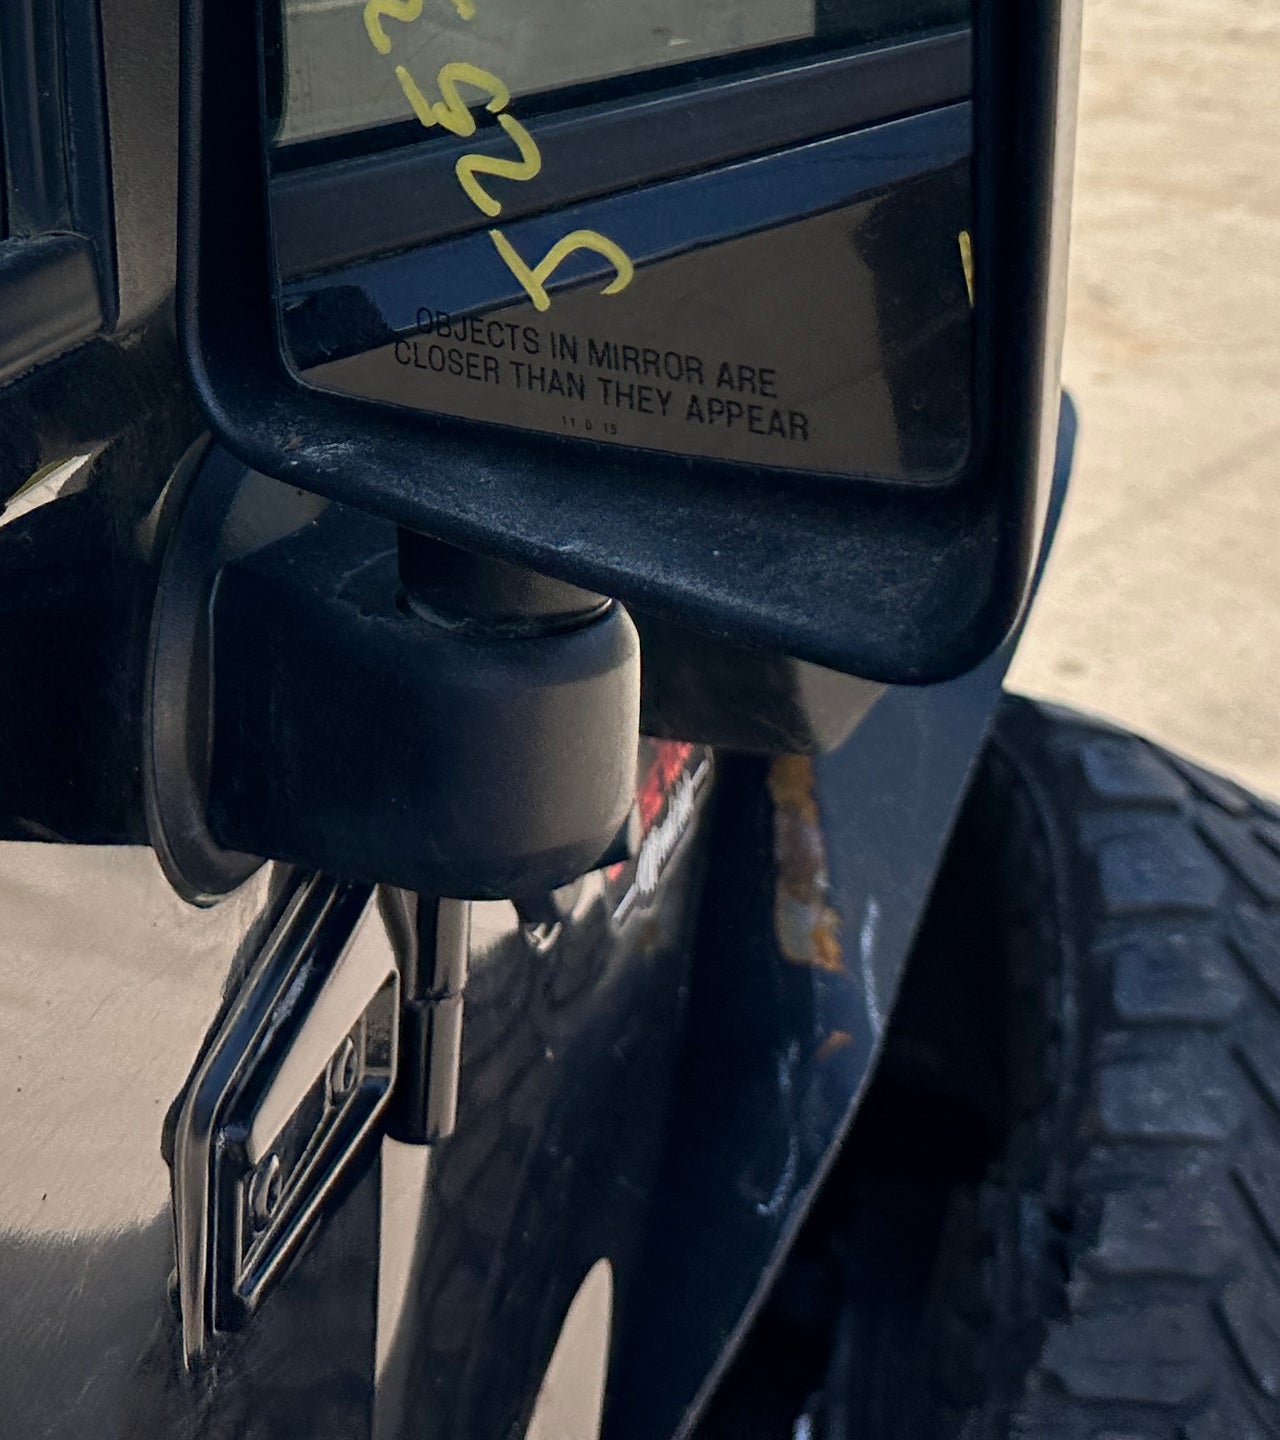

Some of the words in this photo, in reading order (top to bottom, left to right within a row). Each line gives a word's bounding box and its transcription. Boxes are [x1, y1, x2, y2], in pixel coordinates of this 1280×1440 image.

[393, 338, 501, 385] CLOSER
[509, 360, 586, 402] THAN
[597, 376, 674, 418] THEY
[684, 393, 810, 442] APPEAR
[415, 305, 540, 356] OBJECTS
[549, 330, 578, 364] IN
[587, 338, 705, 387] MIRROR
[716, 361, 779, 401] ARE
